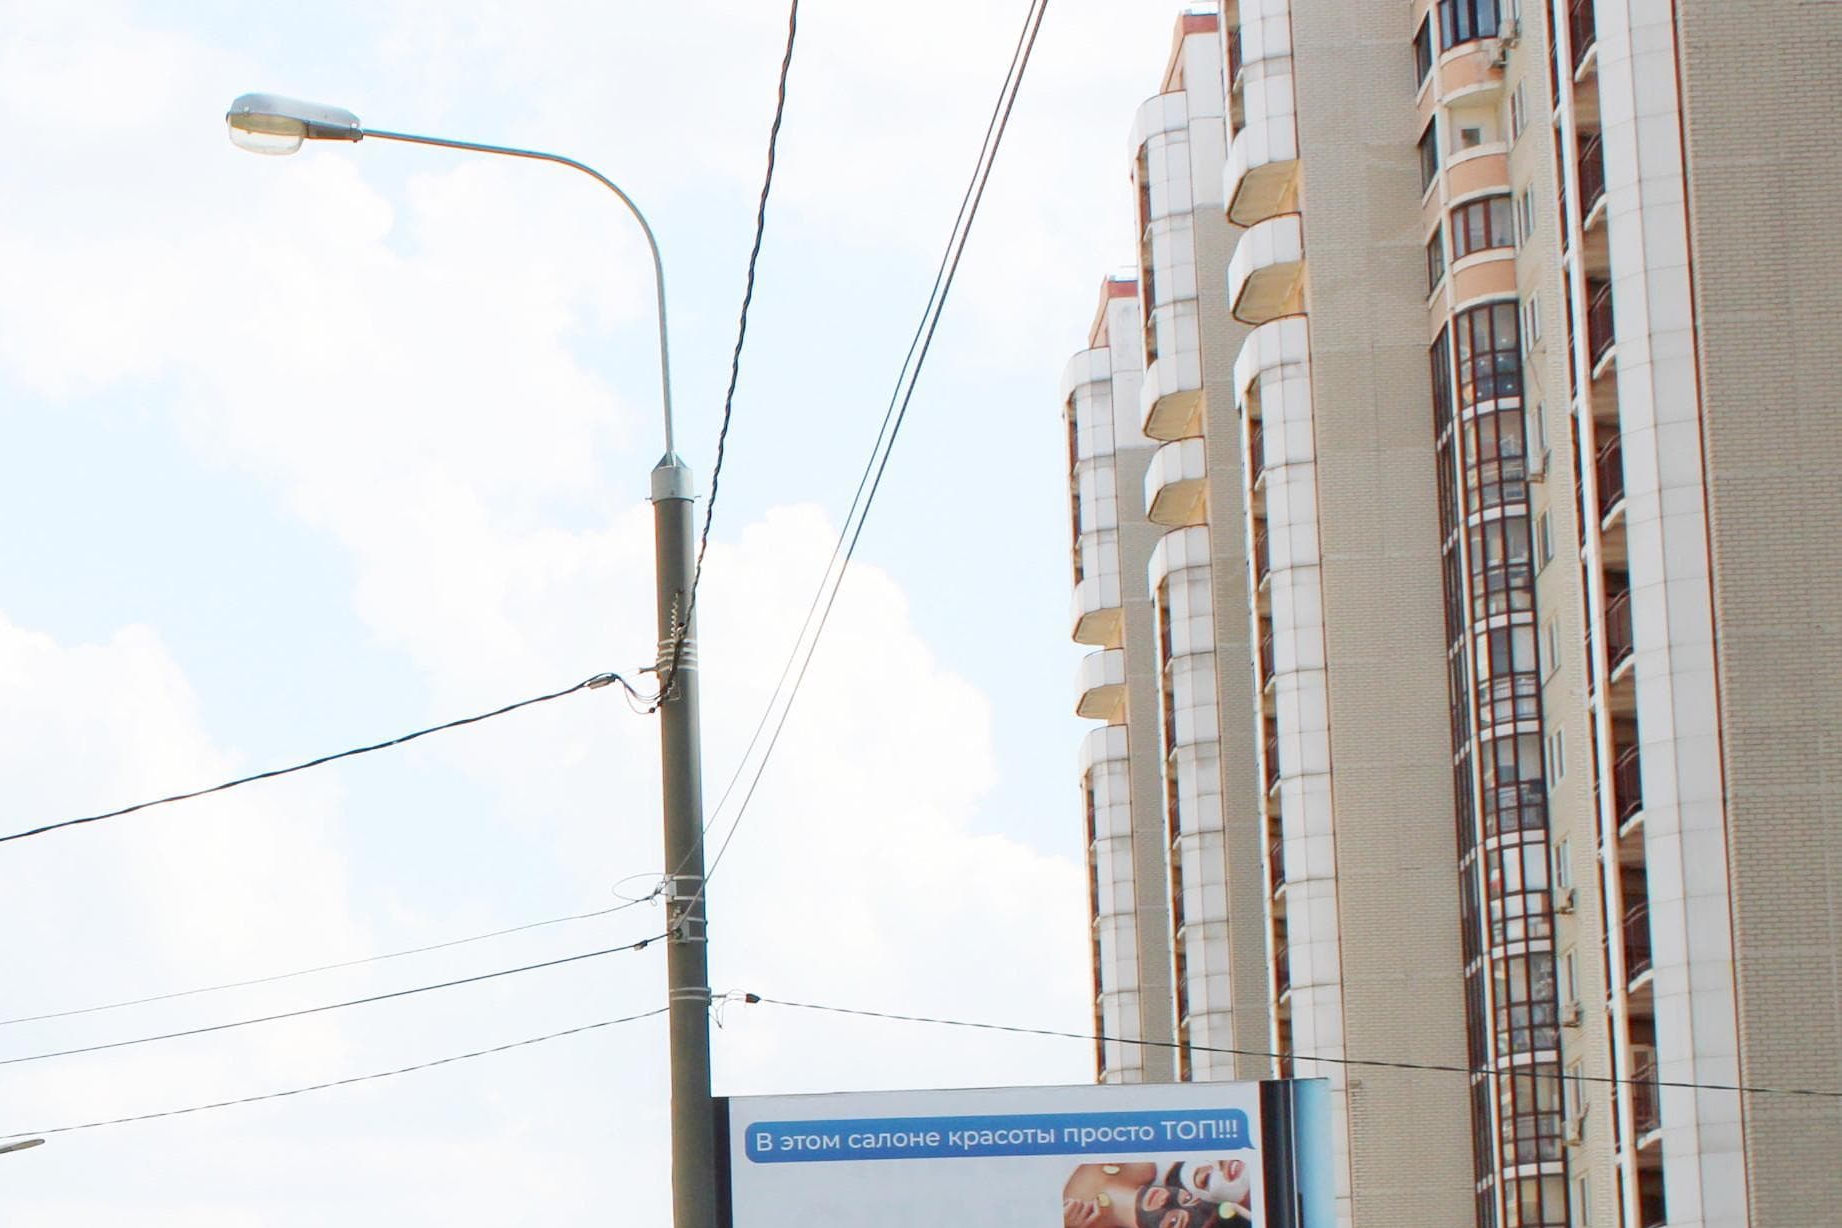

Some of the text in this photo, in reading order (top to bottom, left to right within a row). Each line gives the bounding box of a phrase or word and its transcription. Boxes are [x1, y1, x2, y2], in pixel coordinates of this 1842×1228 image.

[756, 1119, 1238, 1151] В этом салоне красоты просто ТОП!!!
